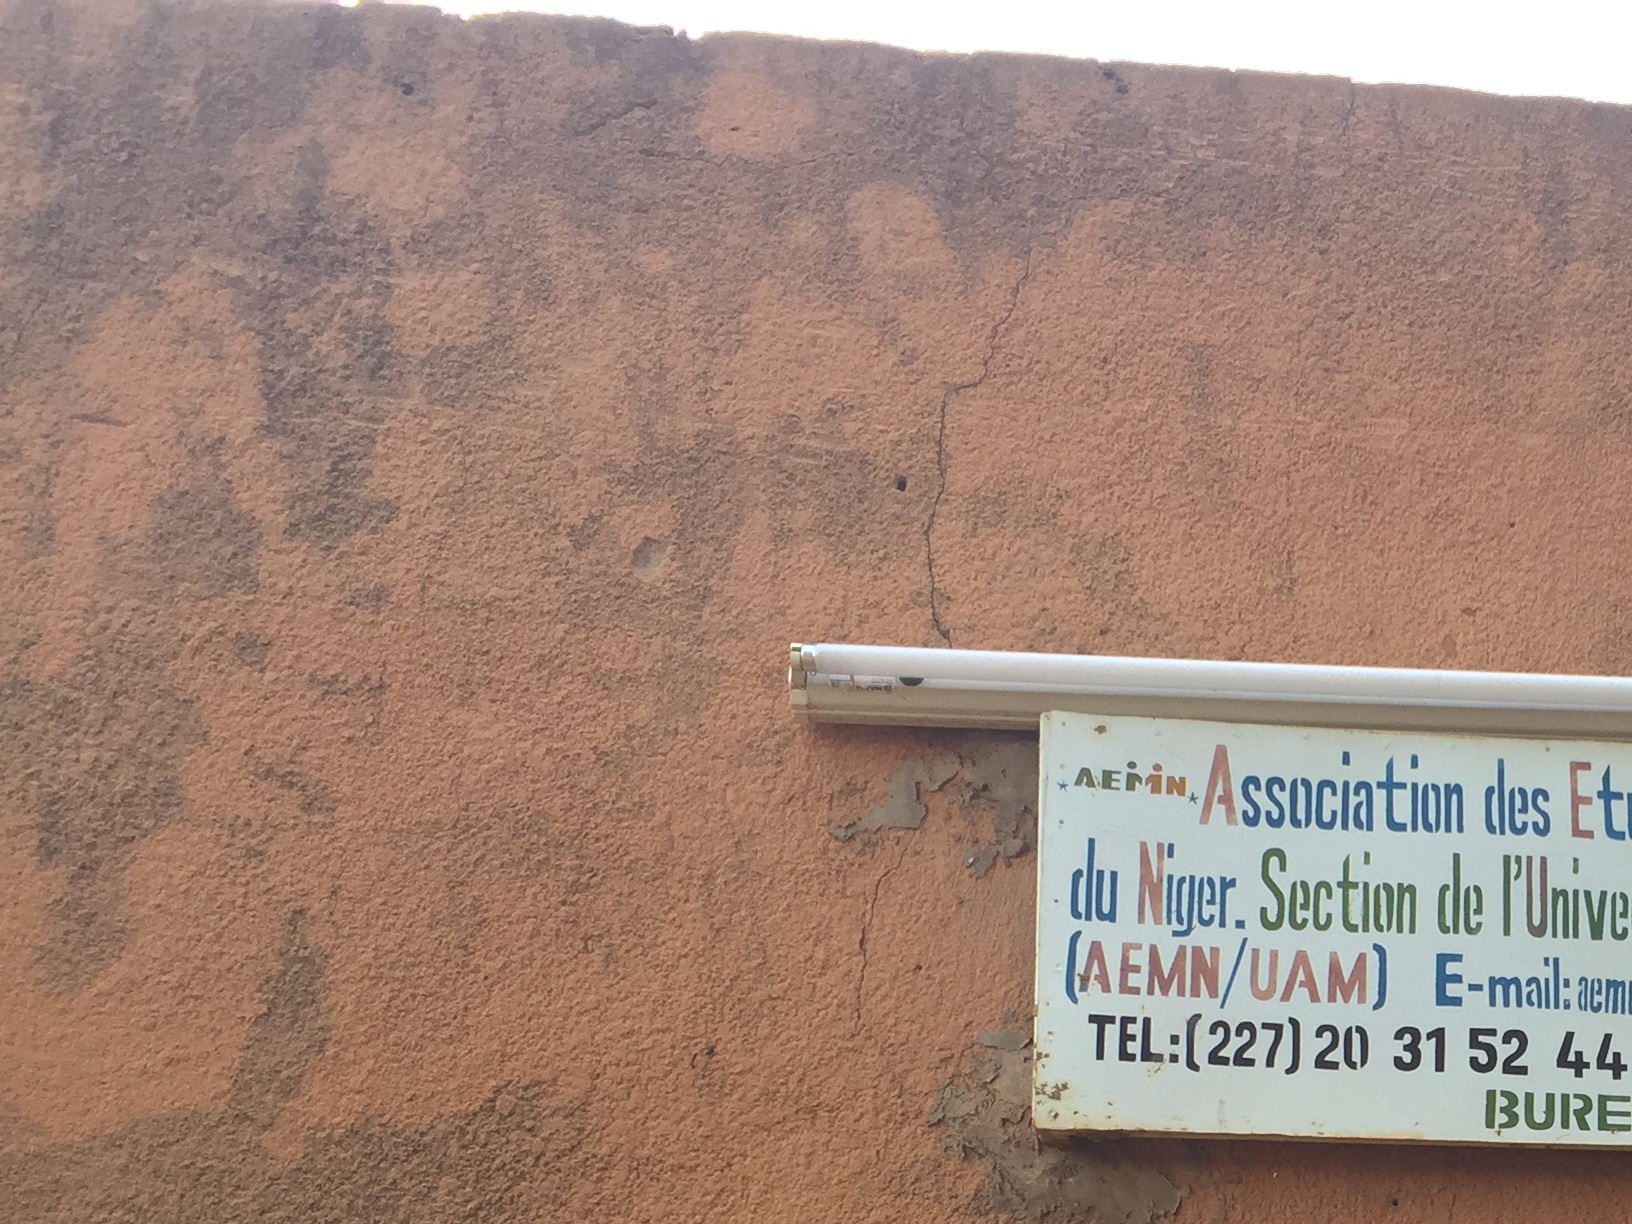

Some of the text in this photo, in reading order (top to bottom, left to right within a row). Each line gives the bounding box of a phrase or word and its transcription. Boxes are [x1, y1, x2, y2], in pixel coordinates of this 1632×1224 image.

[1199, 744, 1464, 834] Association
[1484, 758, 1551, 837] des
[1069, 837, 1118, 924] du
[1137, 841, 1246, 938] Niger.
[1259, 847, 1417, 934] Section
[1437, 853, 1484, 936] de
[1064, 930, 1388, 1012] (AEMN/UAM)
[1435, 953, 1571, 1011] E-mail:
[1088, 1012, 1301, 1075] TEL:(227)
[1314, 1024, 1369, 1070] 20
[1393, 1026, 1446, 1073] 31
[1469, 1028, 1528, 1076] 52
[1556, 1031, 1628, 1080] 44
